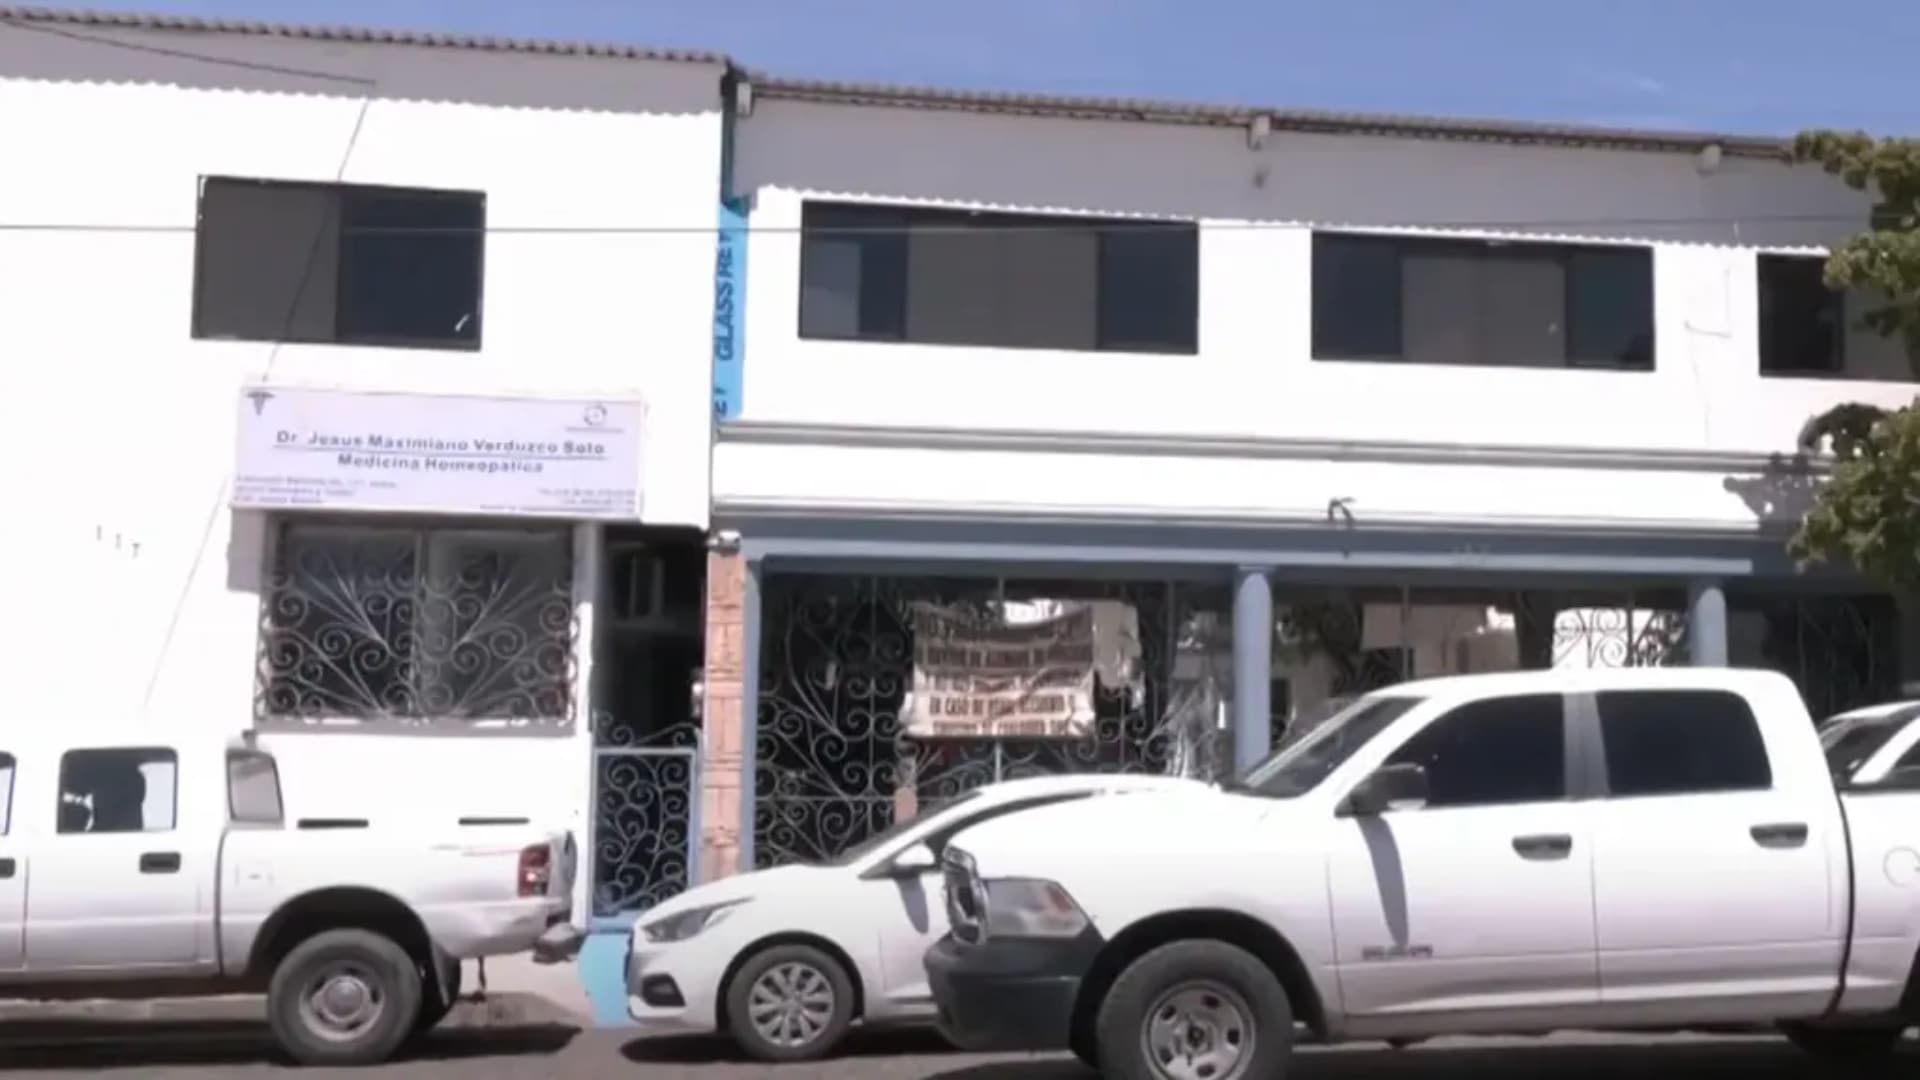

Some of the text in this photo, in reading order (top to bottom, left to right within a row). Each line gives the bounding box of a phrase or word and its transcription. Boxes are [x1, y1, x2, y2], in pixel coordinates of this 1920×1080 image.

[715, 282, 734, 360] GLASS
[368, 434, 468, 452] Maximiano
[474, 438, 558, 454] Verduzco
[563, 440, 605, 454] Soto
[337, 453, 420, 470] Medicina
